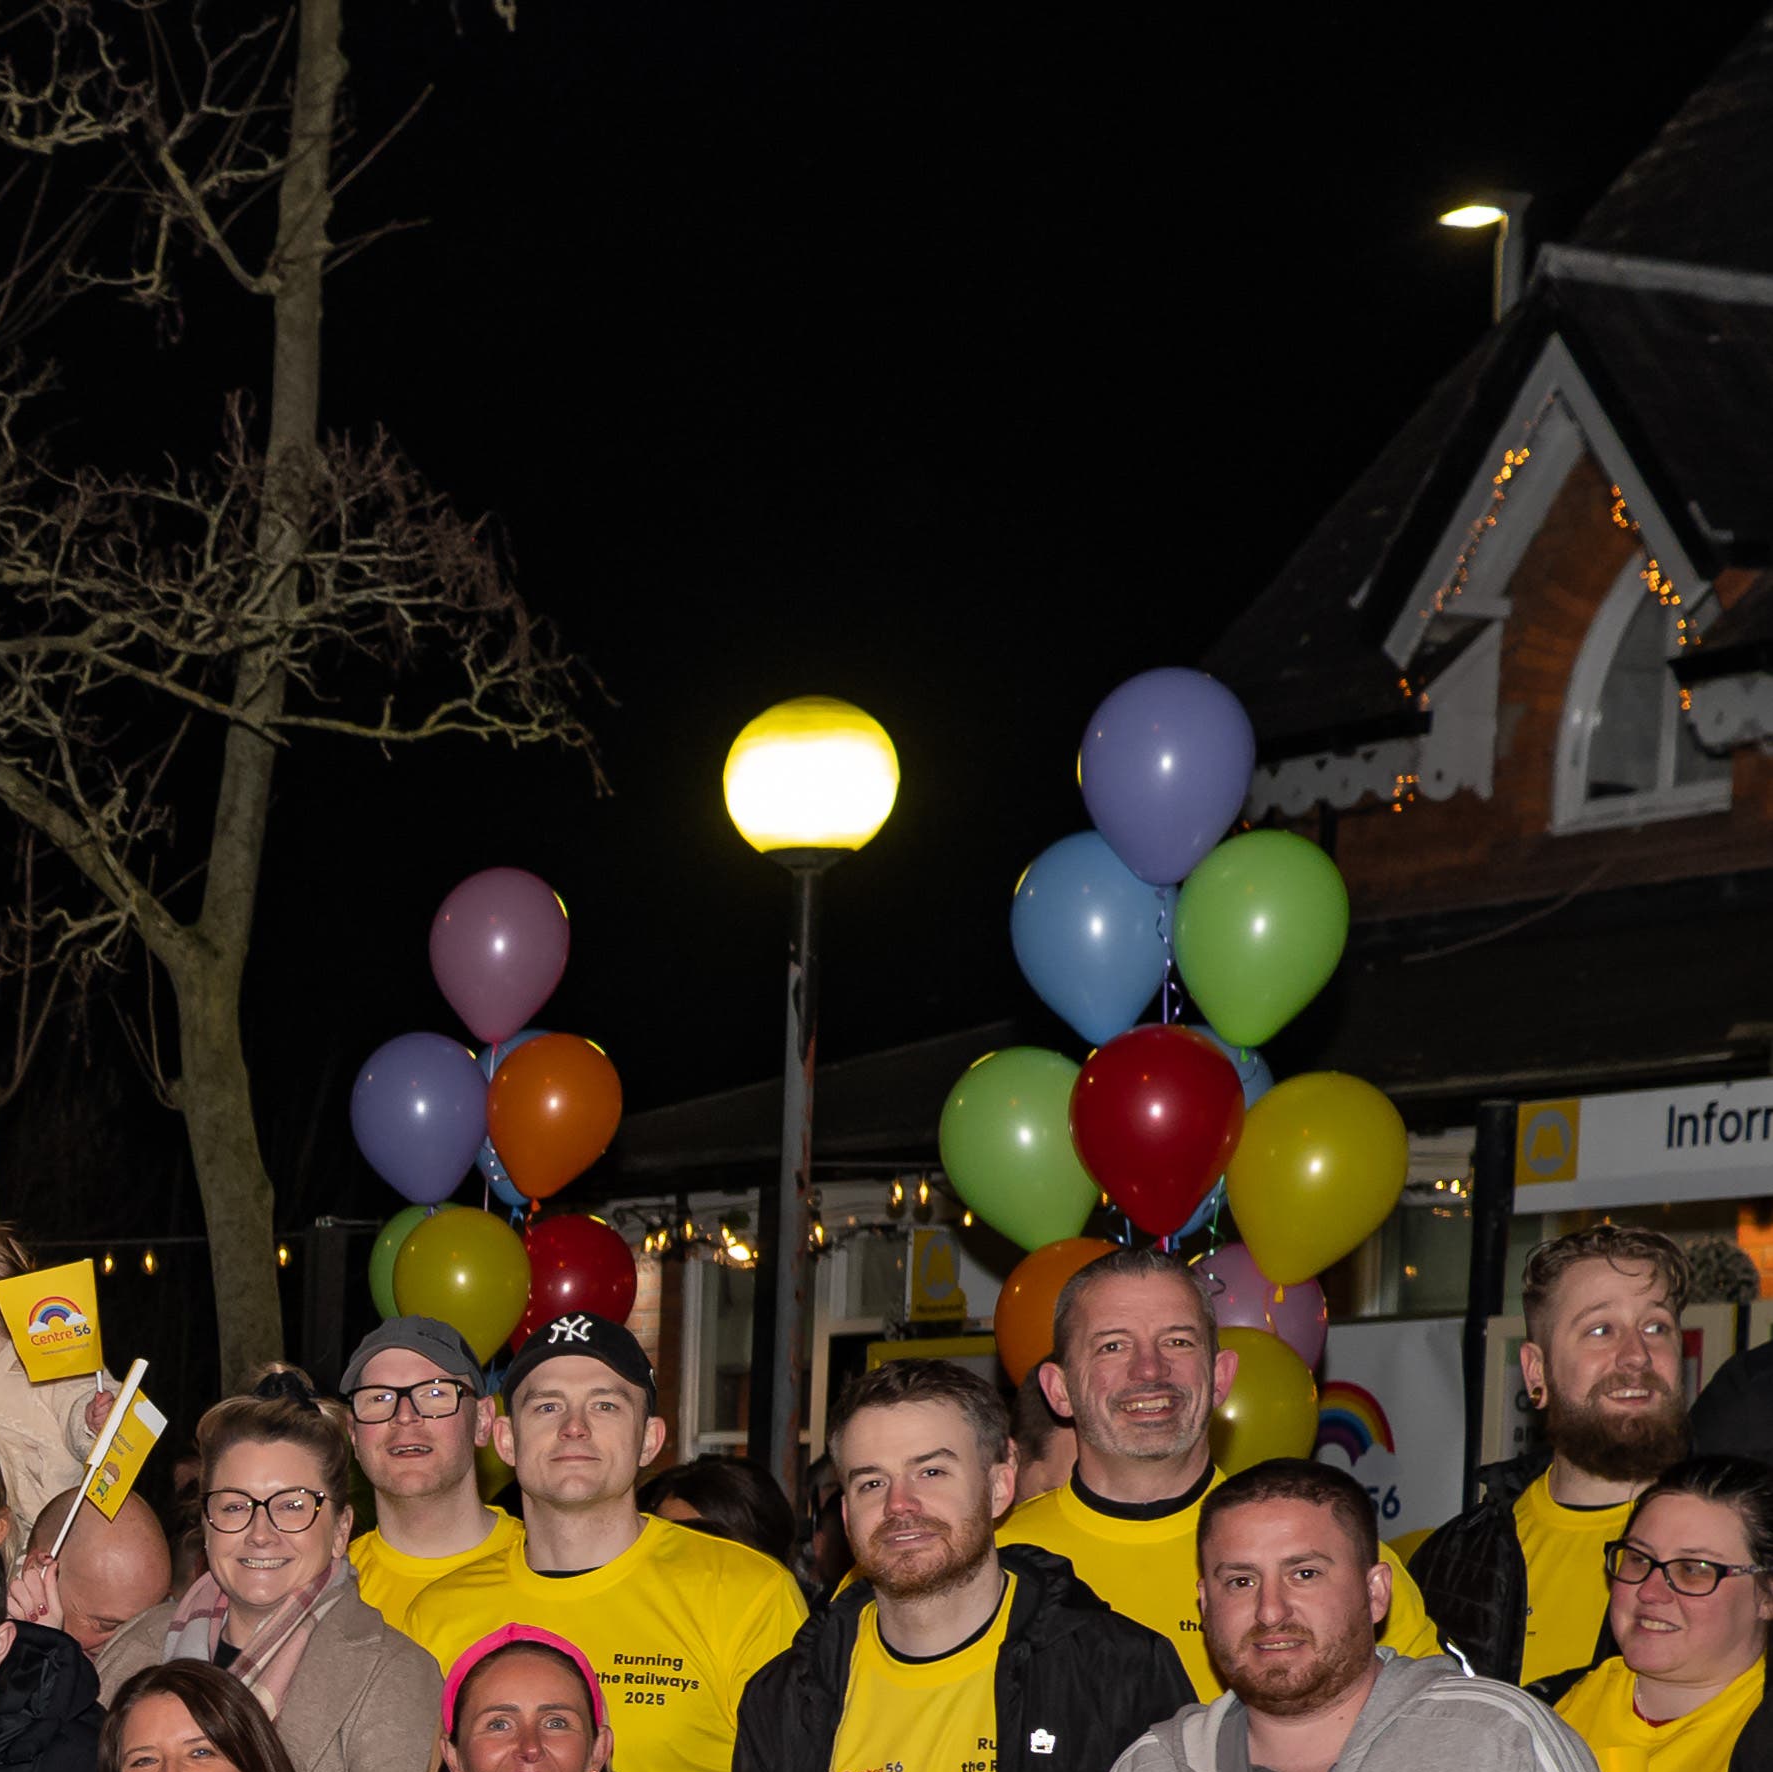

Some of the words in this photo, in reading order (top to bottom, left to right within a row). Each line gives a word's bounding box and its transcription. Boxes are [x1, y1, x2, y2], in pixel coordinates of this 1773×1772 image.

[30, 1330, 73, 1346] Centre
[73, 1323, 91, 1337] 56
[613, 1653, 683, 1671] Running
[624, 1672, 700, 1692] Railways
[625, 1692, 666, 1706] 2025
